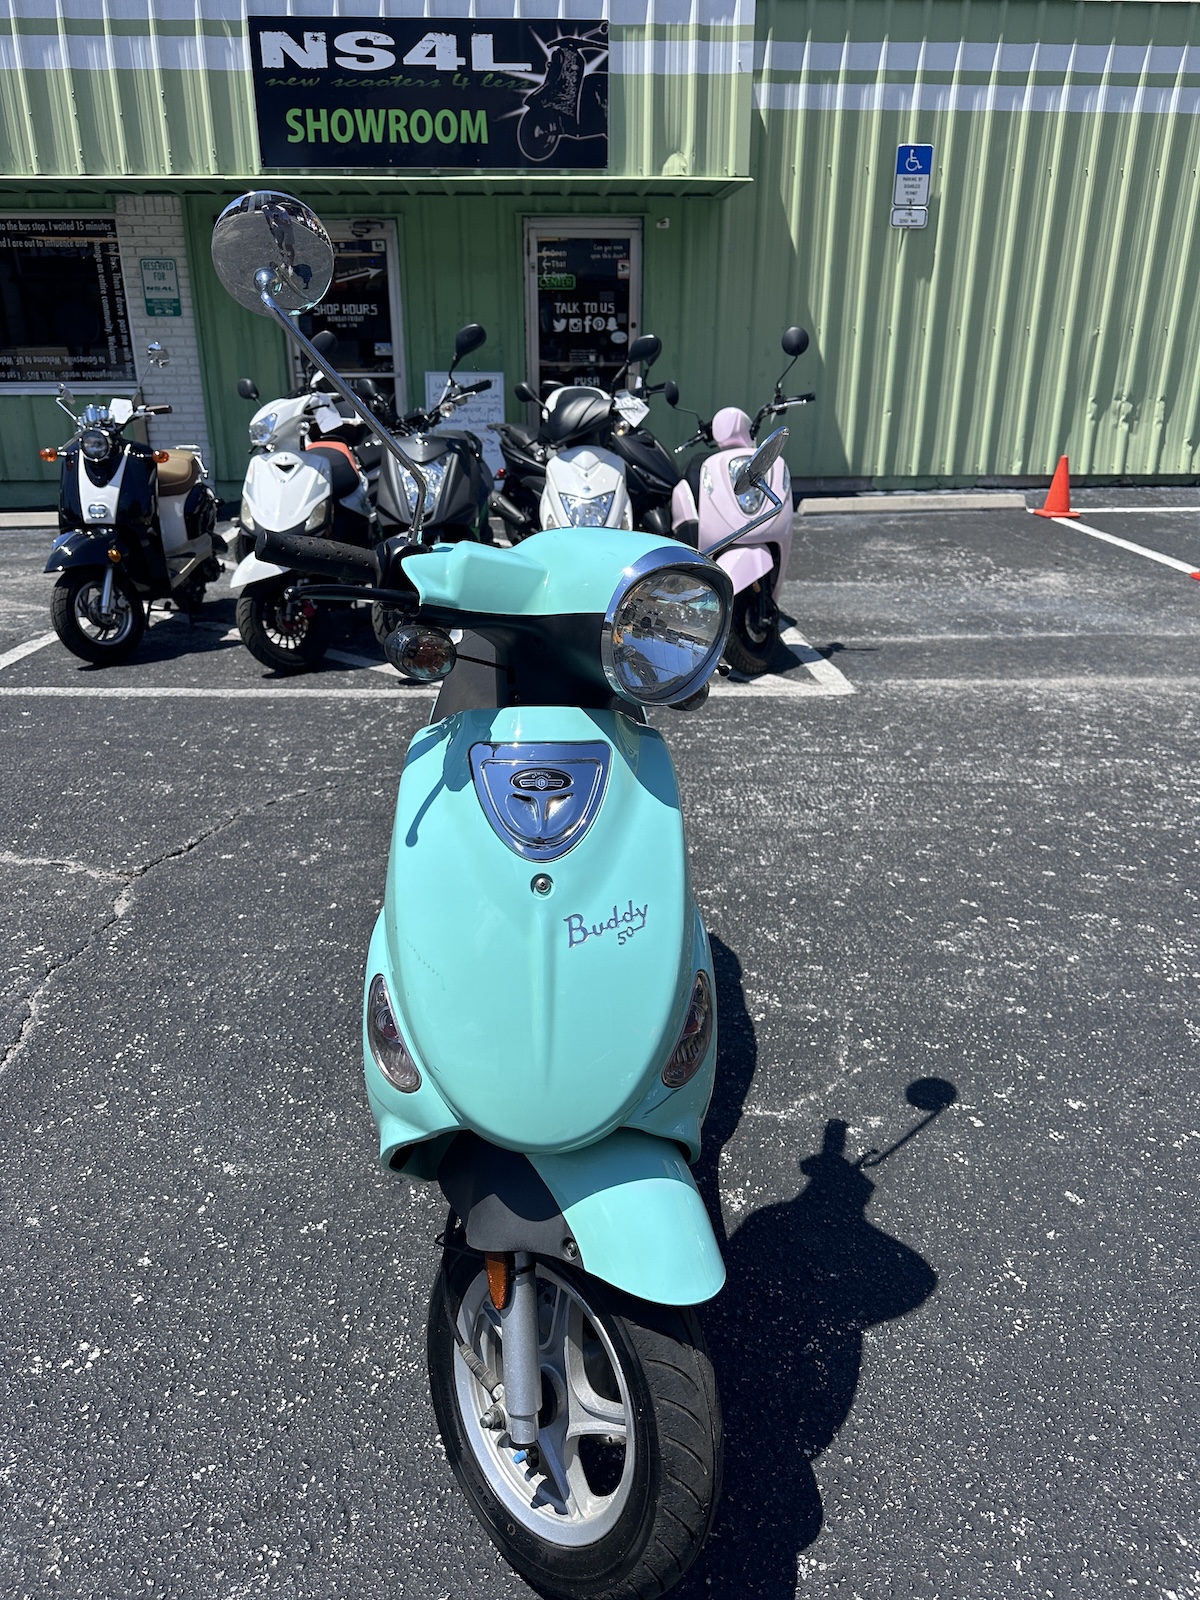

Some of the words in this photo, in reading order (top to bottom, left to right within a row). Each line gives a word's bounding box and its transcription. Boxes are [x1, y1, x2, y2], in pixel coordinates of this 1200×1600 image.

[258, 30, 533, 72] NS4L
[265, 77, 321, 87] new
[331, 74, 442, 88] scooters
[453, 73, 471, 90] 4
[479, 73, 534, 89] less
[286, 107, 489, 145] SHOWROOM
[7, 220, 17, 230] the
[18, 220, 31, 230] bus
[31, 221, 48, 232] stop.
[53, 221, 75, 231] waited
[76, 221, 84, 230] 15
[85, 221, 112, 231] minutes
[24, 239, 35, 247] out
[36, 239, 43, 247] to
[75, 239, 88, 247] and
[93, 239, 103, 262] hange
[96, 263, 104, 273] an
[143, 261, 174, 270] RESERVED
[112, 272, 122, 289] Then
[153, 272, 166, 280] FOR
[98, 274, 108, 294] entire
[115, 296, 125, 316] drove
[313, 303, 339, 316] SHOP
[342, 303, 378, 315] HOURS
[554, 302, 580, 314] TALK
[583, 302, 597, 313] TO
[600, 302, 615, 314] US
[25, 356, 32, 364] to
[32, 356, 61, 365] Welcome
[574, 376, 600, 387] PUSH
[563, 900, 648, 948] Buddy
[618, 926, 634, 945] 50
